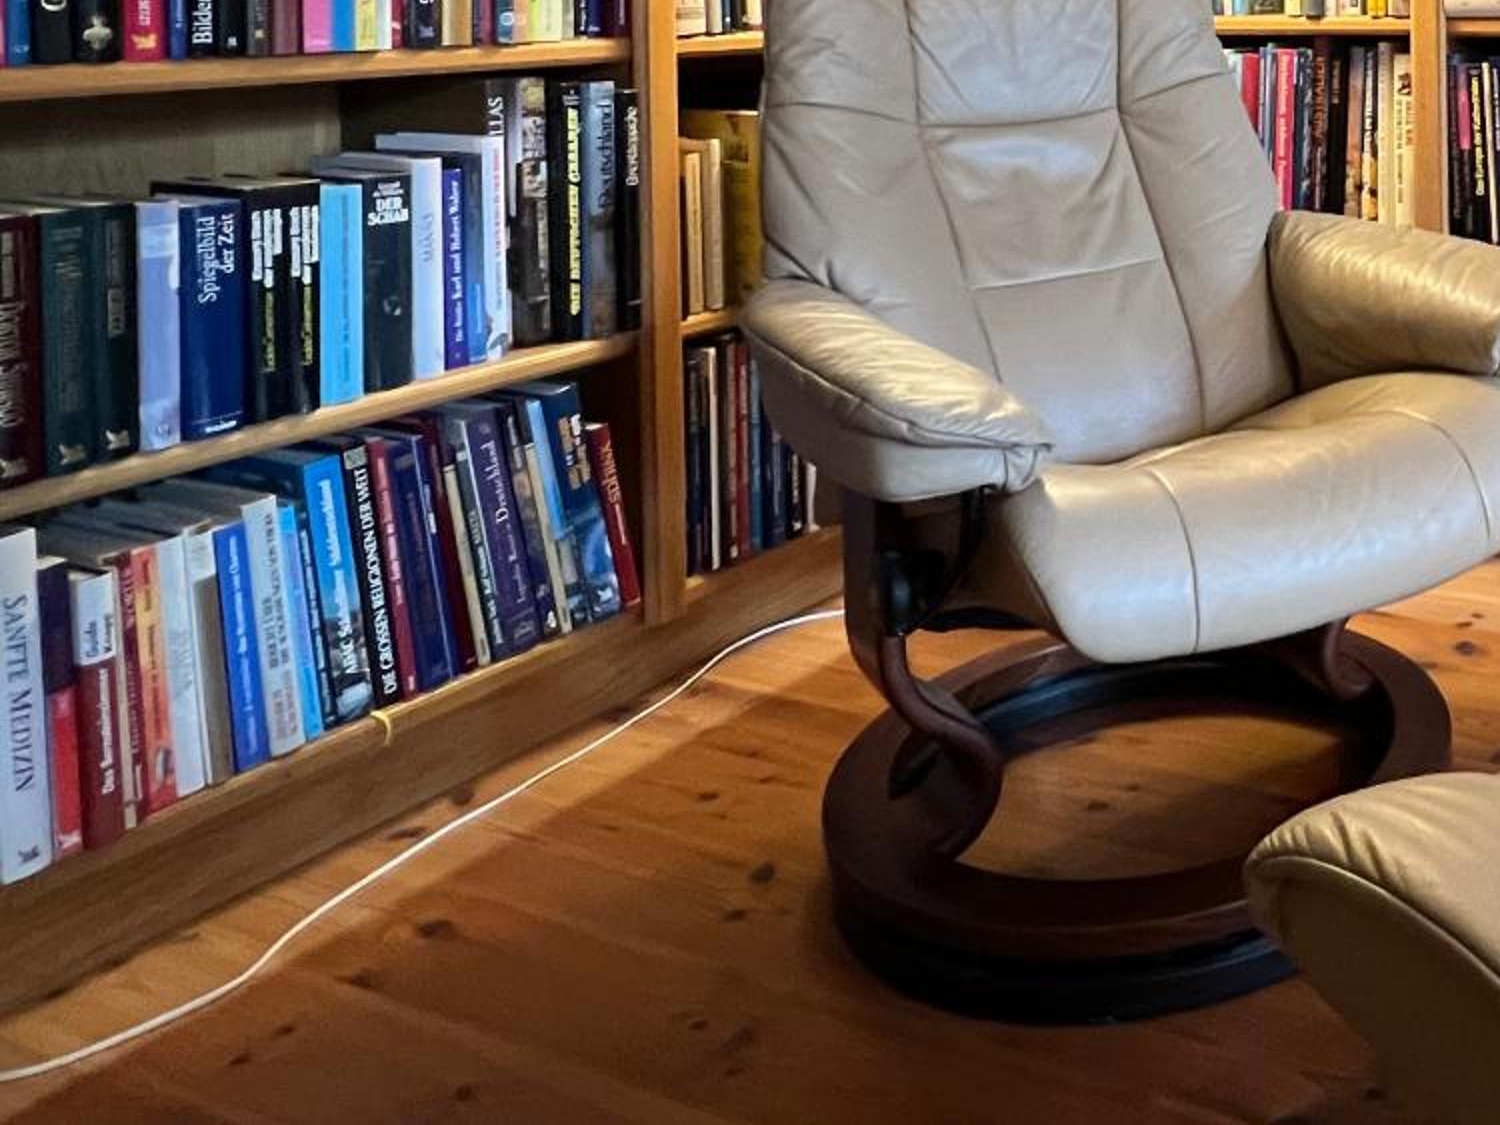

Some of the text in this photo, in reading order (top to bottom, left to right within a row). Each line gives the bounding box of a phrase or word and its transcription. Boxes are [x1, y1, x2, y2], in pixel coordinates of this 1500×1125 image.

[198, 216, 220, 304] Spiegelbild
[217, 213, 235, 274] der Zeit
[353, 467, 371, 500] WELT
[482, 439, 511, 524] Deutschland
[358, 500, 375, 534] DER
[363, 534, 387, 608] RELIGIONEN
[374, 608, 396, 671] GROSSEN
[0, 594, 34, 793] SANFTE MEDIZIN
[381, 670, 398, 694] DIE
